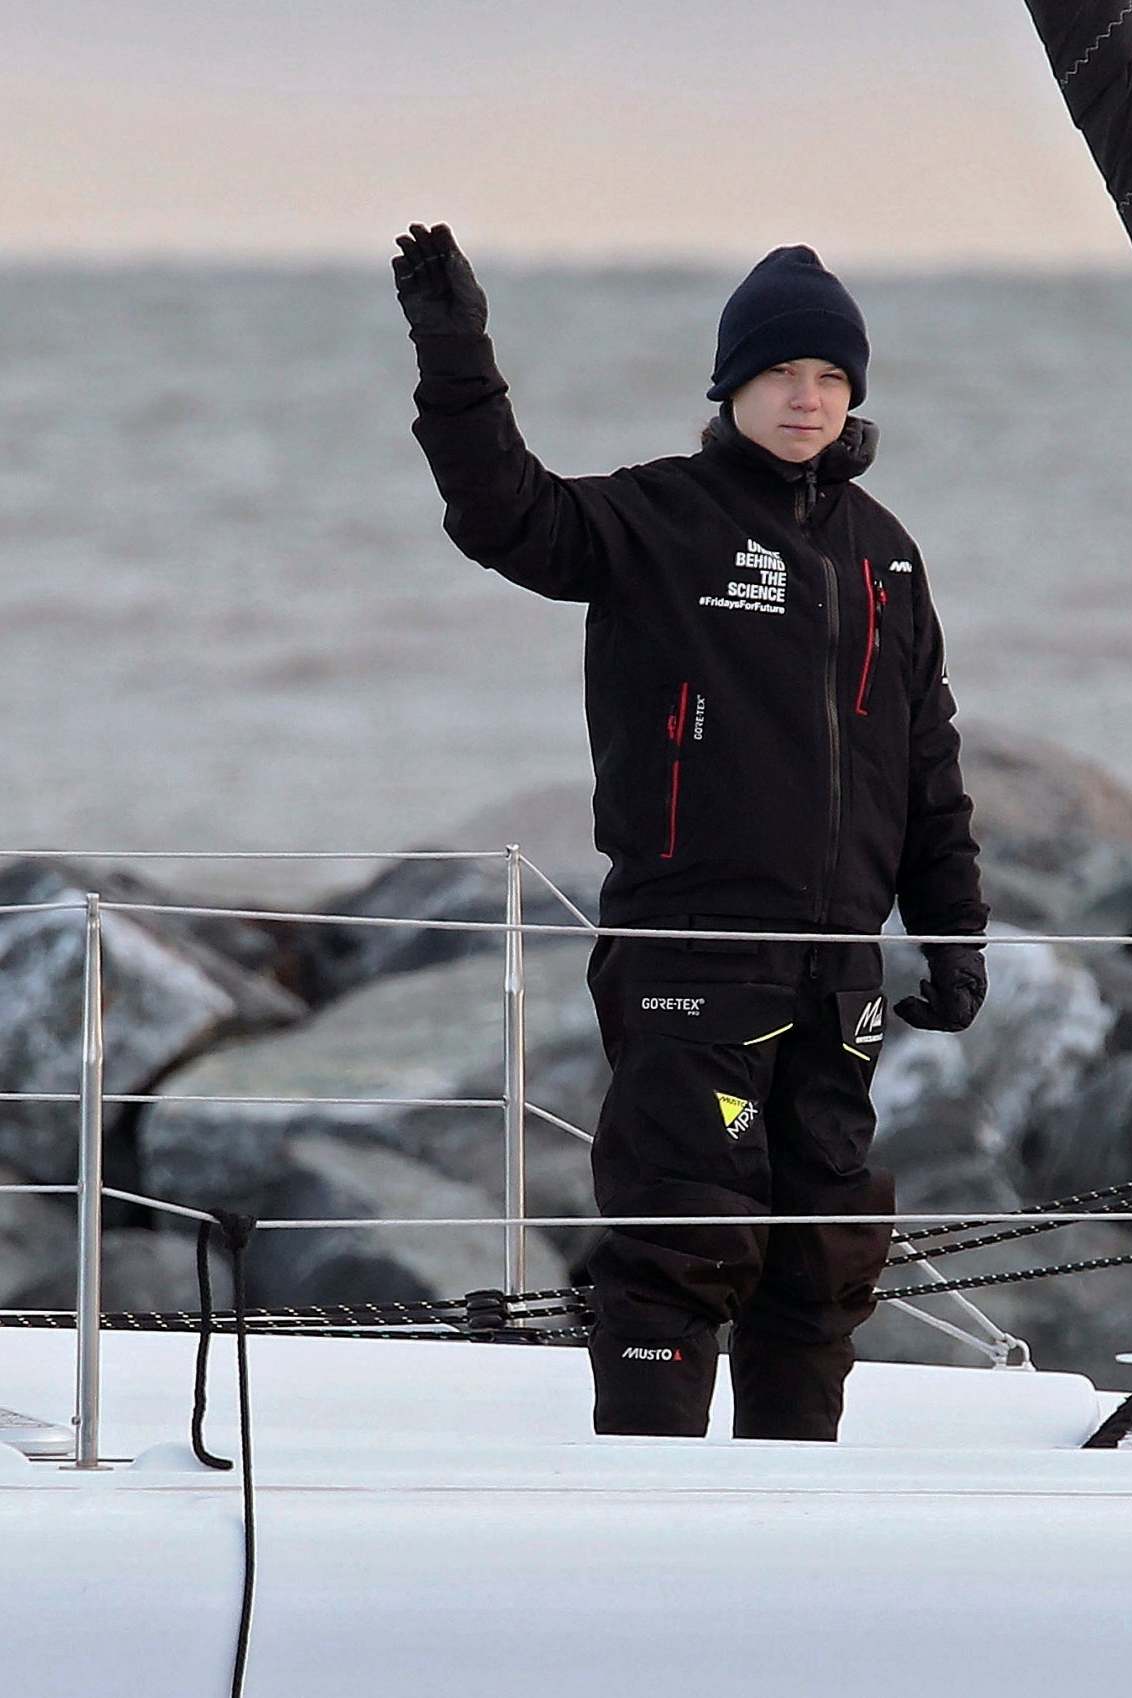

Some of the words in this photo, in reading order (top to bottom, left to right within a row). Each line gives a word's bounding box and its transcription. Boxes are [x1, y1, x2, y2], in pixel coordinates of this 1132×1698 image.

[735, 551, 786, 571] BEHIND
[760, 570, 787, 587] THE
[727, 581, 786, 603] SCIENCE
[698, 596, 785, 614] #FridaysForFuture
[726, 1101, 759, 1139] MPX
[621, 1346, 673, 1361] MUSTO
